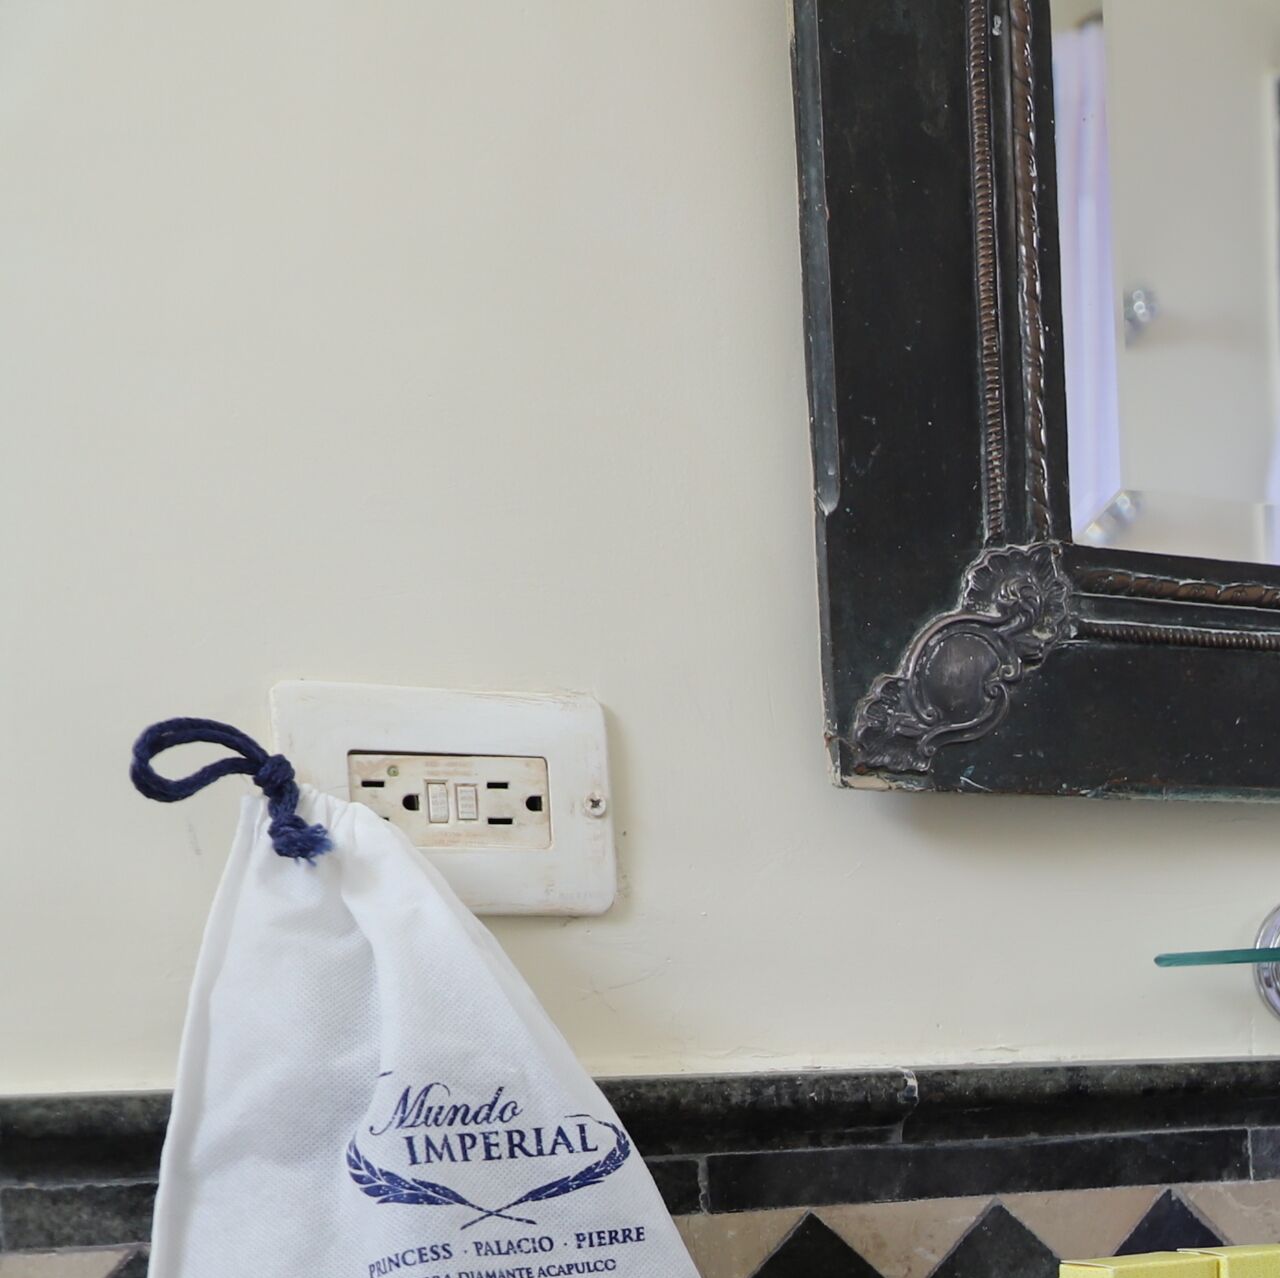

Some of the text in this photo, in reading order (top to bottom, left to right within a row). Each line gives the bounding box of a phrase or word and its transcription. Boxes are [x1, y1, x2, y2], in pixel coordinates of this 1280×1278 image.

[369, 1082, 523, 1135] Mundo
[404, 1123, 598, 1166] IMPERIAL
[474, 1235, 555, 1256] PALACIO
[575, 1226, 646, 1249] PIERRE
[537, 1258, 617, 1278] ACAPULCO
